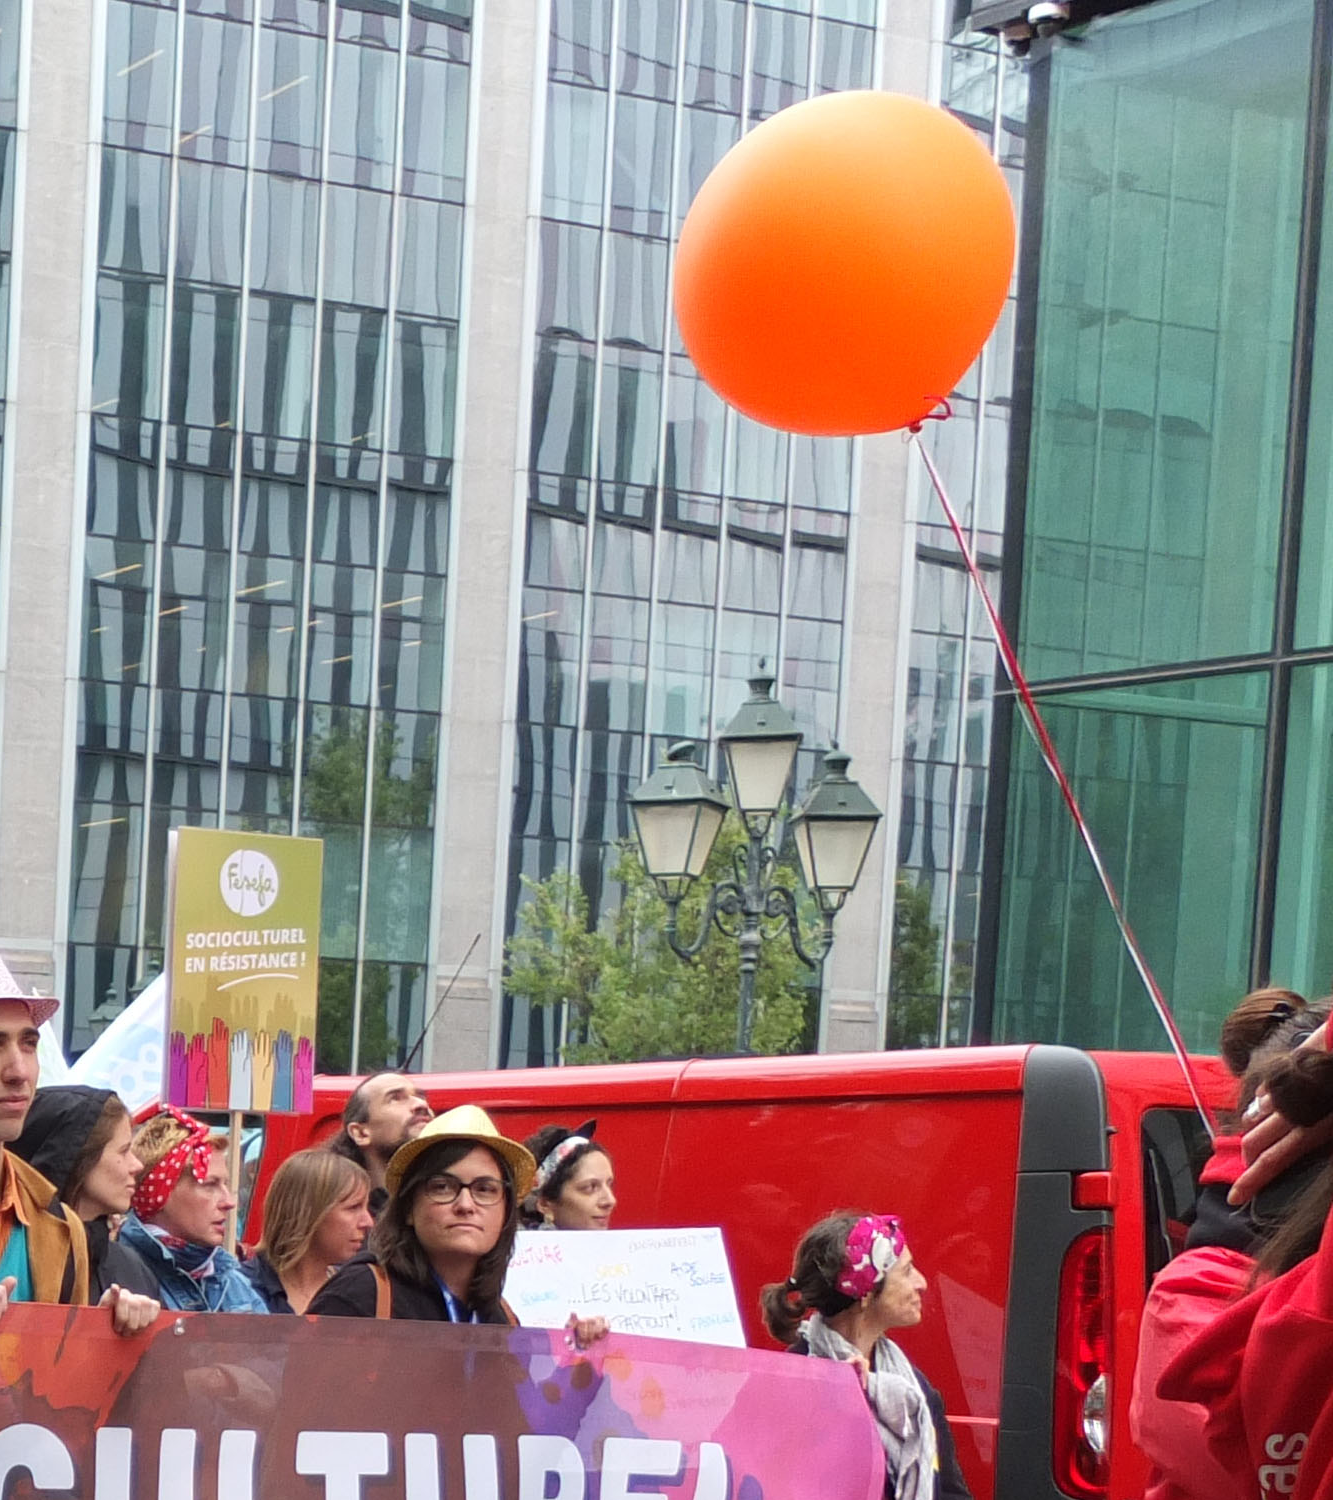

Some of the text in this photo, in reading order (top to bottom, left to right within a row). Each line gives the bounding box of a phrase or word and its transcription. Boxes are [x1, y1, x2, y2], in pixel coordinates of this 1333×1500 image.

[185, 927, 307, 950] SOCIOCULTUREL
[185, 958, 206, 974] EN
[209, 951, 297, 973] RÉSISTANCE
